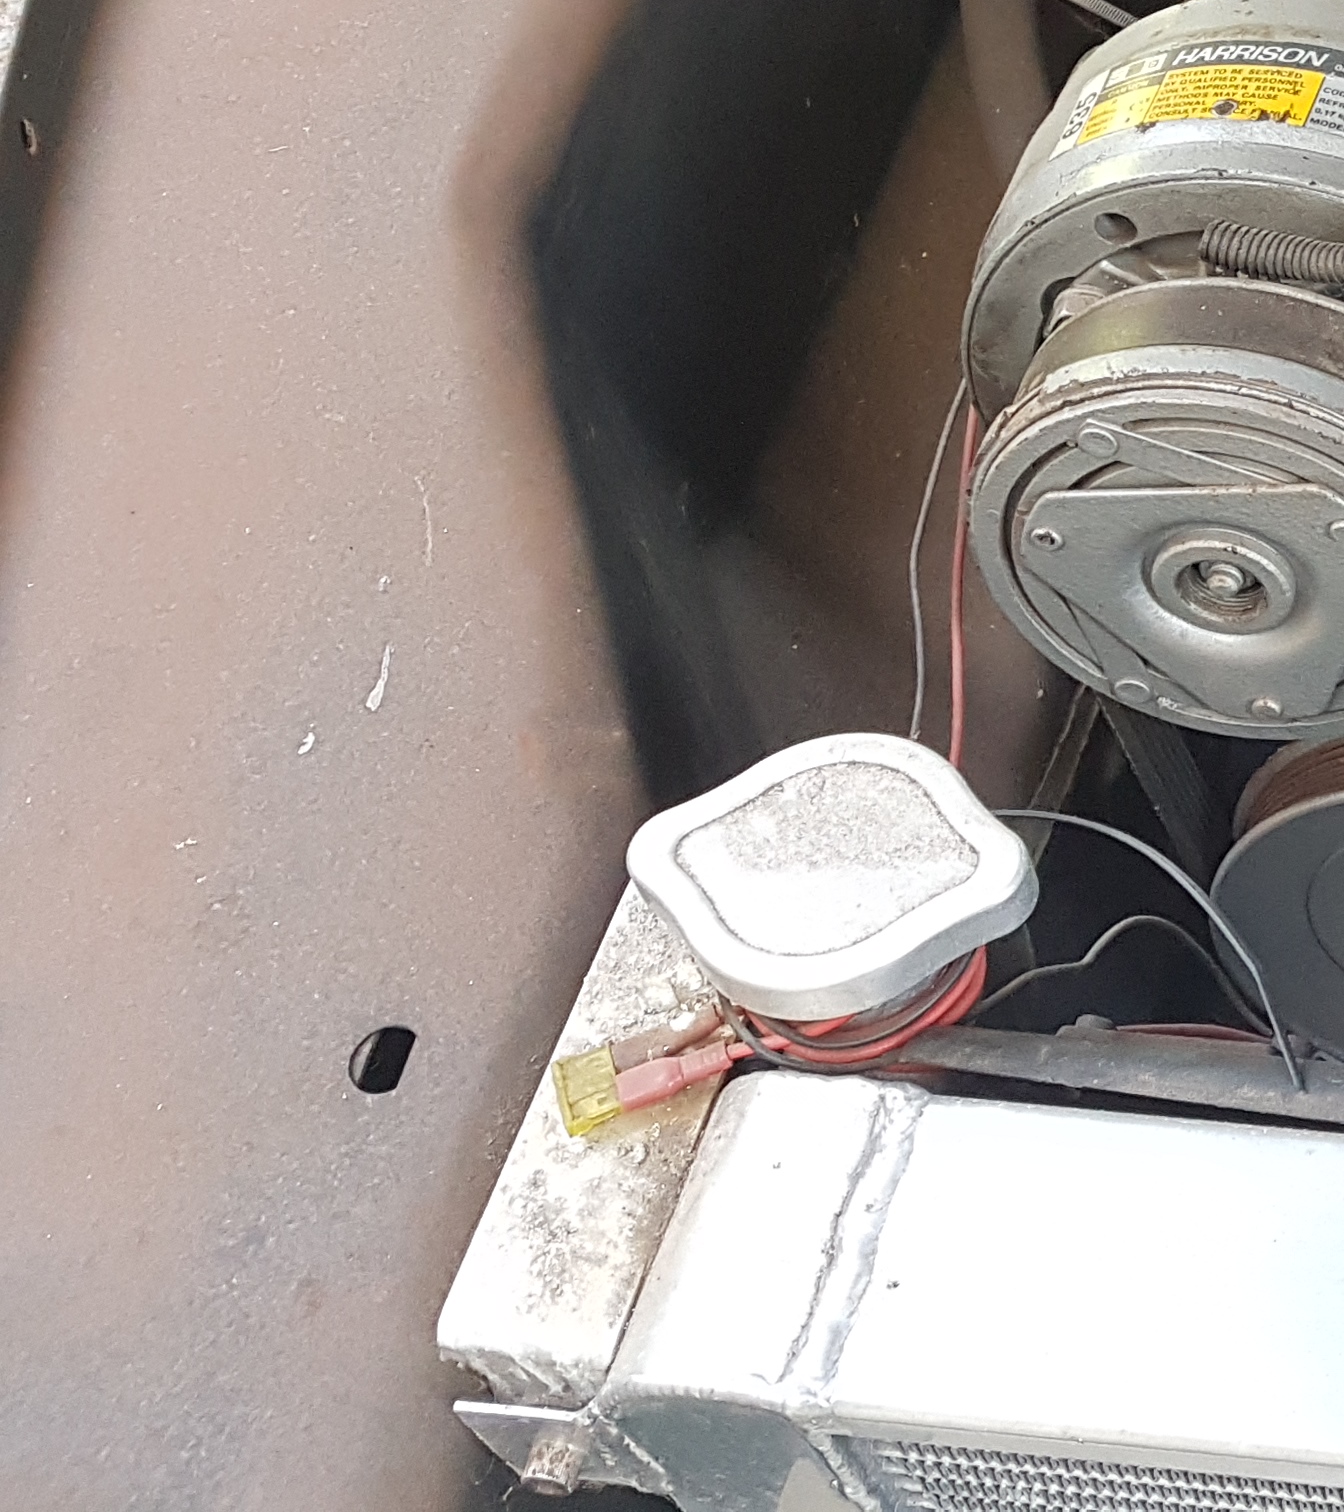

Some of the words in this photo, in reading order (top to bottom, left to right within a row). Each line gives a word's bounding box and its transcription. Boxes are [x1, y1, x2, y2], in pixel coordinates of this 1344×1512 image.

[1172, 45, 1330, 67] HARRISON
[1168, 69, 1209, 79] SYSTEM
[1180, 76, 1238, 85] QUALIFIED
[1241, 76, 1306, 88] PERSONNEL
[1241, 92, 1279, 100] CAUSE
